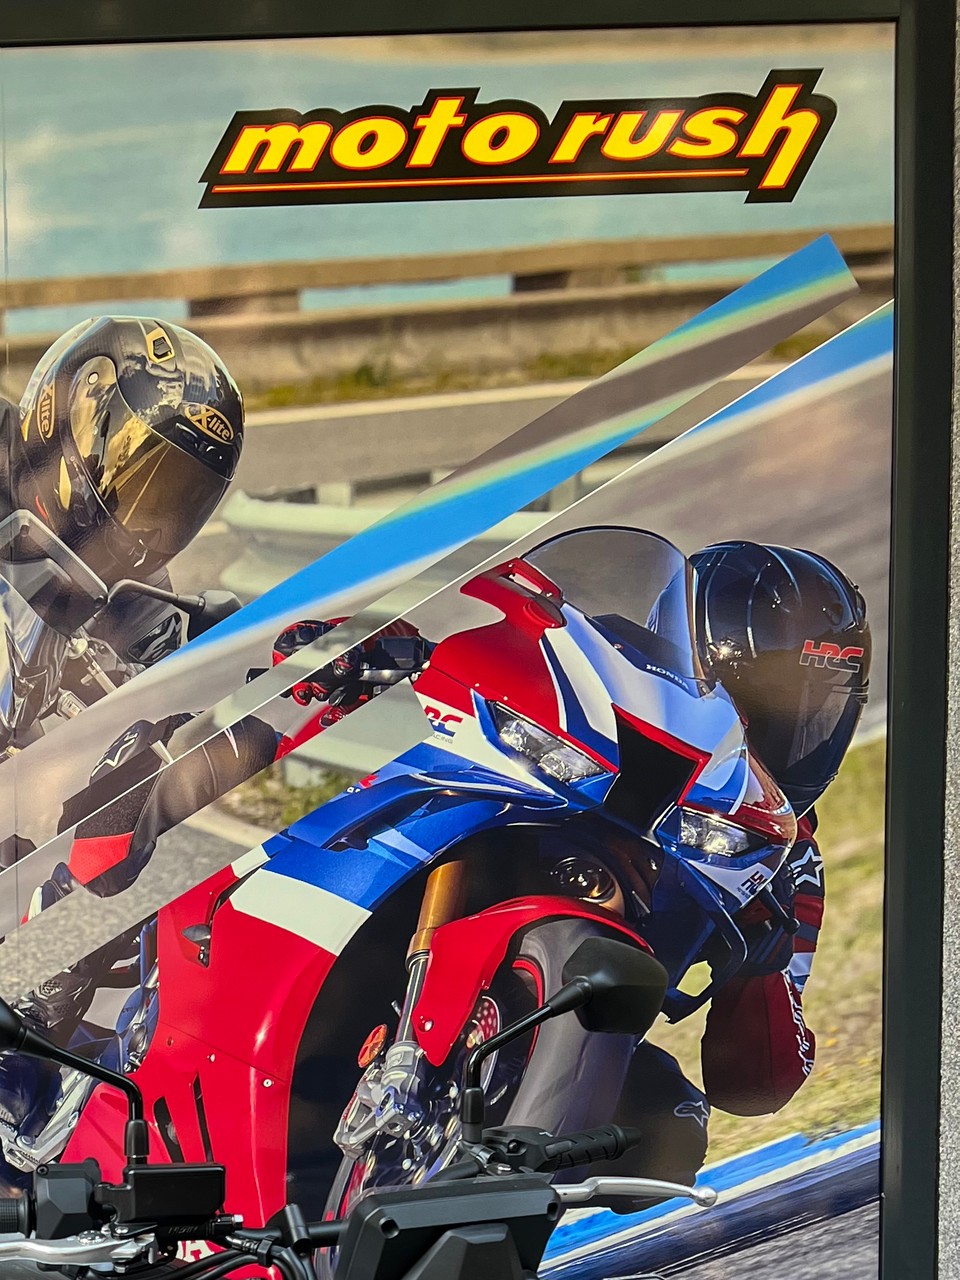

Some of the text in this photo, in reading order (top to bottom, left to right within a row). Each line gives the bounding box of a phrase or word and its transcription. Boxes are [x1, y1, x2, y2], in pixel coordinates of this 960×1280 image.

[40, 382, 56, 435] X-lite
[190, 405, 232, 442] X-lite
[799, 639, 864, 674] HRC
[645, 663, 690, 690] HONDA
[424, 705, 464, 737] RC
